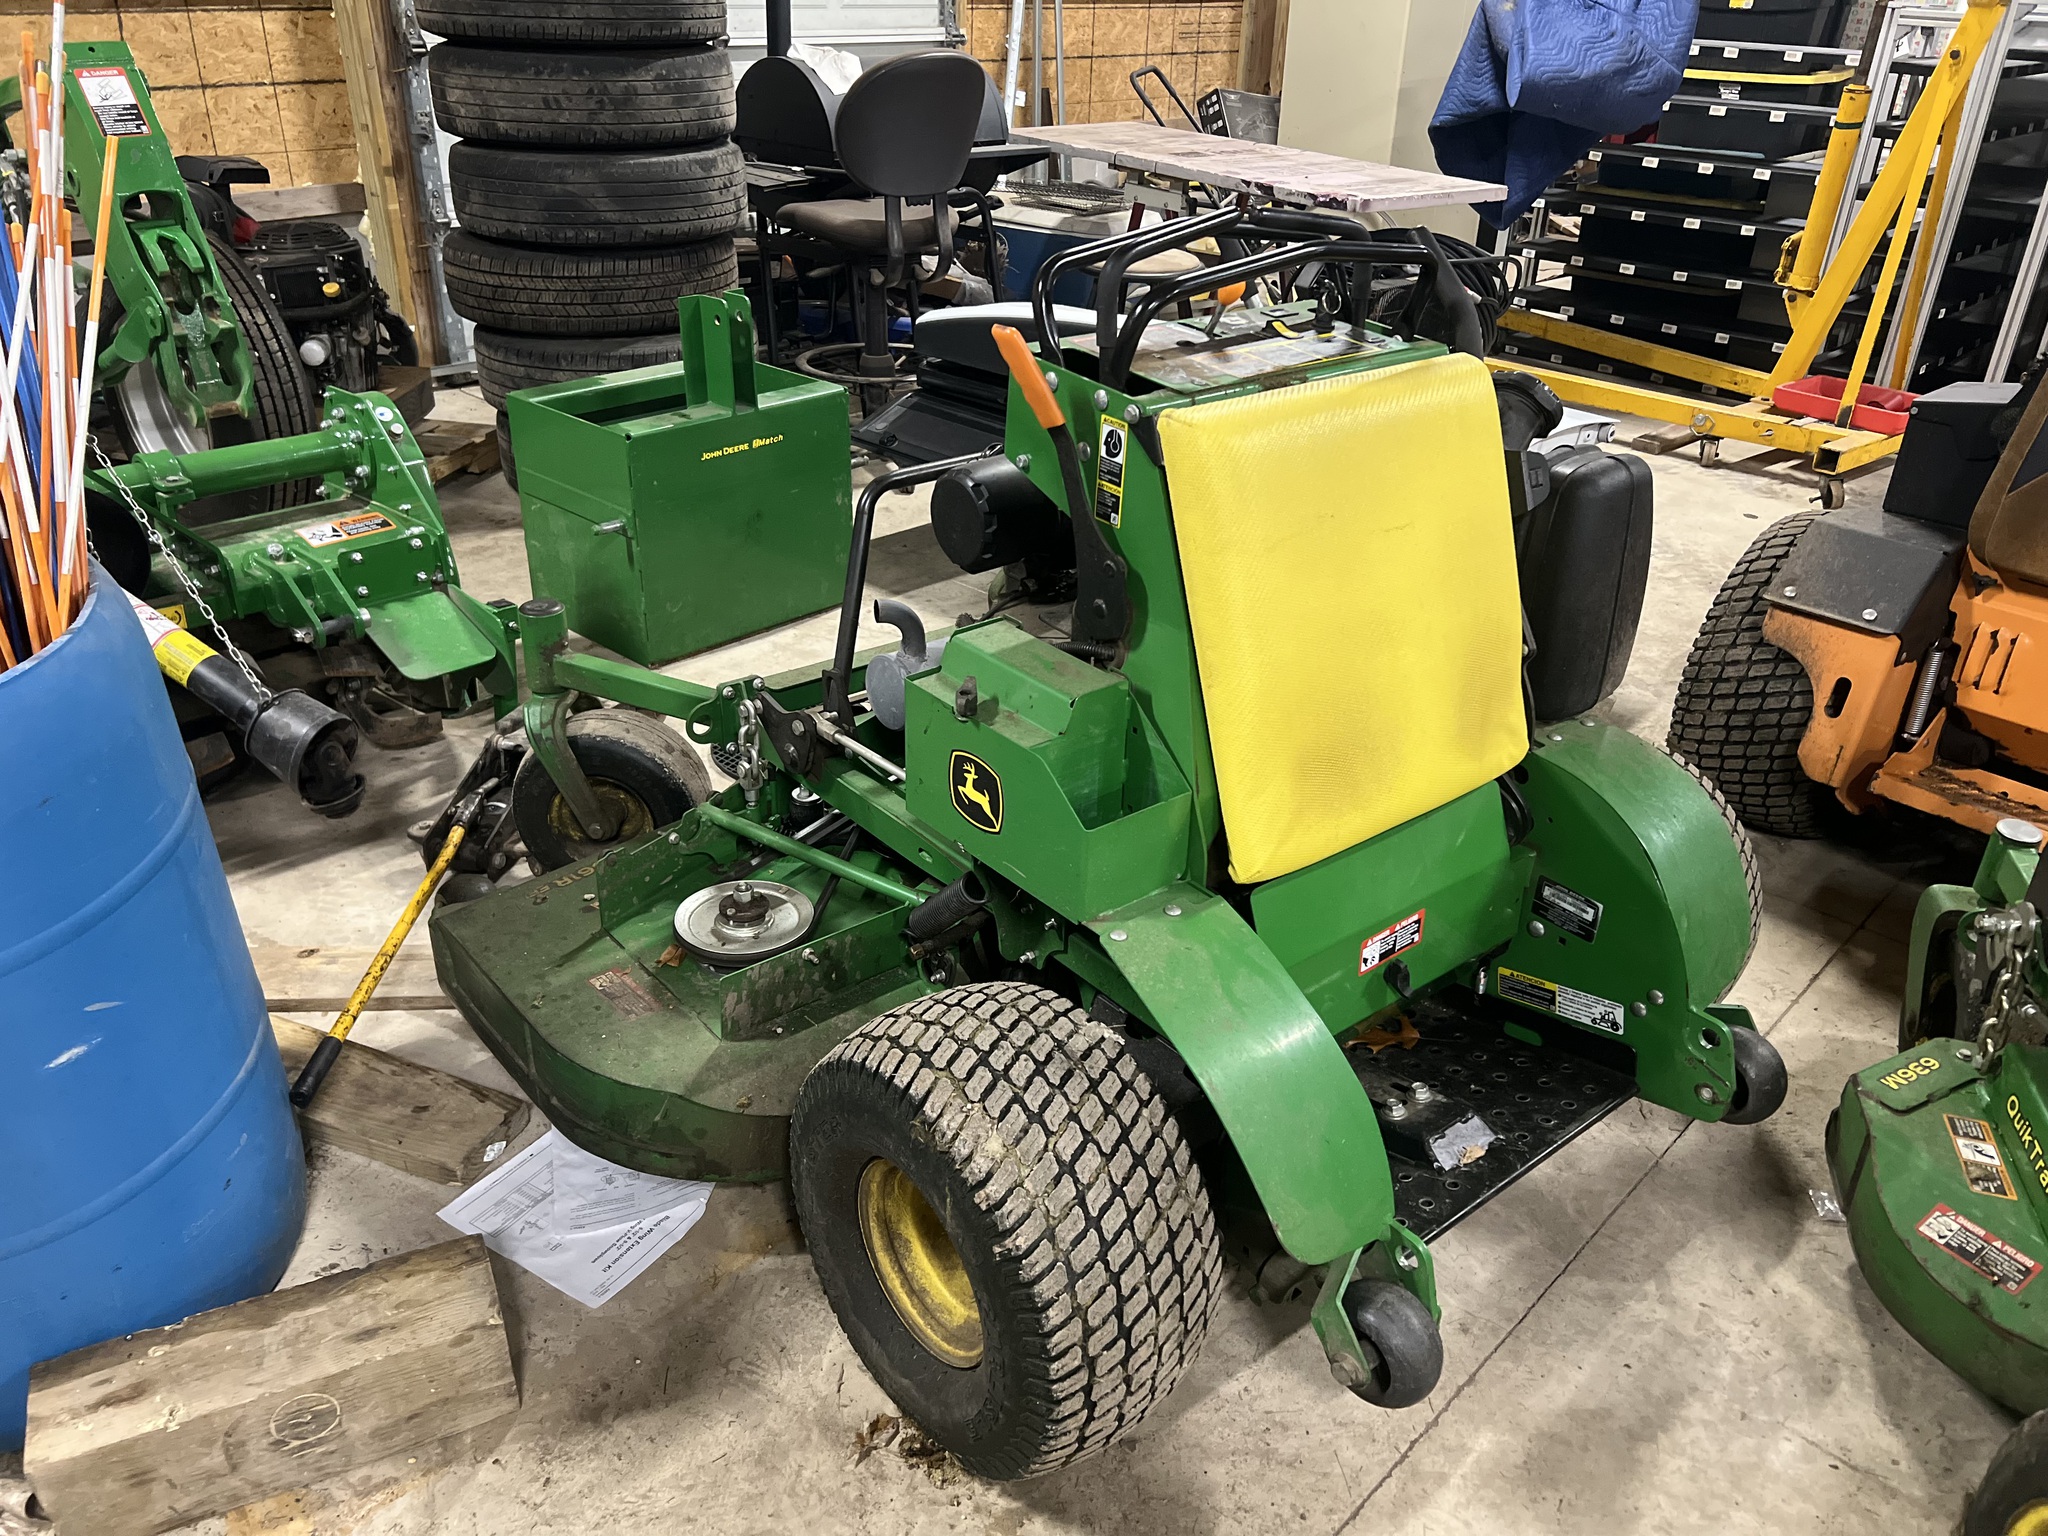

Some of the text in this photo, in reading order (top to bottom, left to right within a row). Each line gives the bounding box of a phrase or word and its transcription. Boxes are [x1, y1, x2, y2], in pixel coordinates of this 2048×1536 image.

[700, 449, 723, 461] JOHN
[722, 442, 750, 455] DEERE
[1880, 1056, 1941, 1090] 636M
[2006, 1095, 2048, 1194] QuikTra
[1956, 1215, 1987, 1238] DANGER
[601, 1215, 671, 1273] Blade Wing Extension Kit
[2002, 1243, 2036, 1268] PELIGRO
